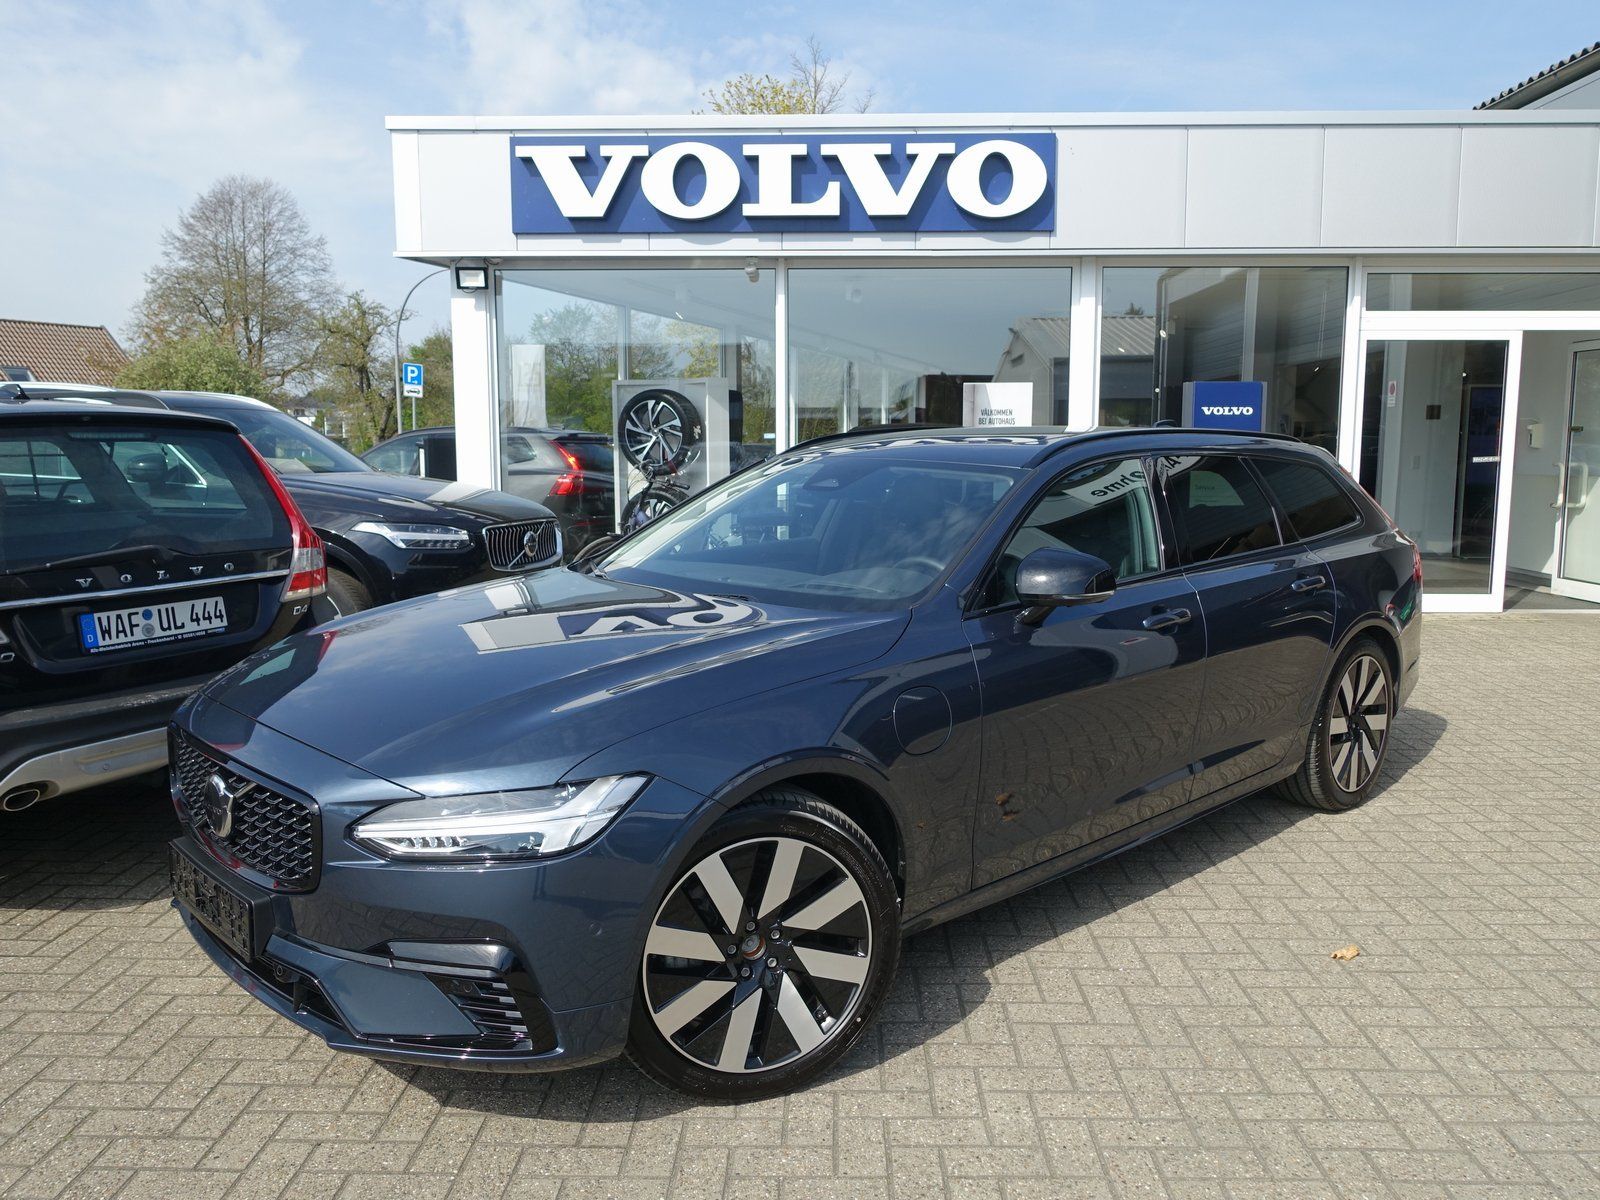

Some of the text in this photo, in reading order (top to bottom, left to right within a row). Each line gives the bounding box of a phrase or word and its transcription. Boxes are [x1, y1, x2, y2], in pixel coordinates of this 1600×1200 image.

[515, 139, 1048, 219] VOLVO
[407, 366, 419, 383] P
[1201, 406, 1254, 416] VOLVO
[988, 417, 1016, 426] AUTOHAUS
[75, 562, 235, 589] VOLVO
[293, 604, 308, 615] D4
[97, 600, 225, 641] WAF UL 444
